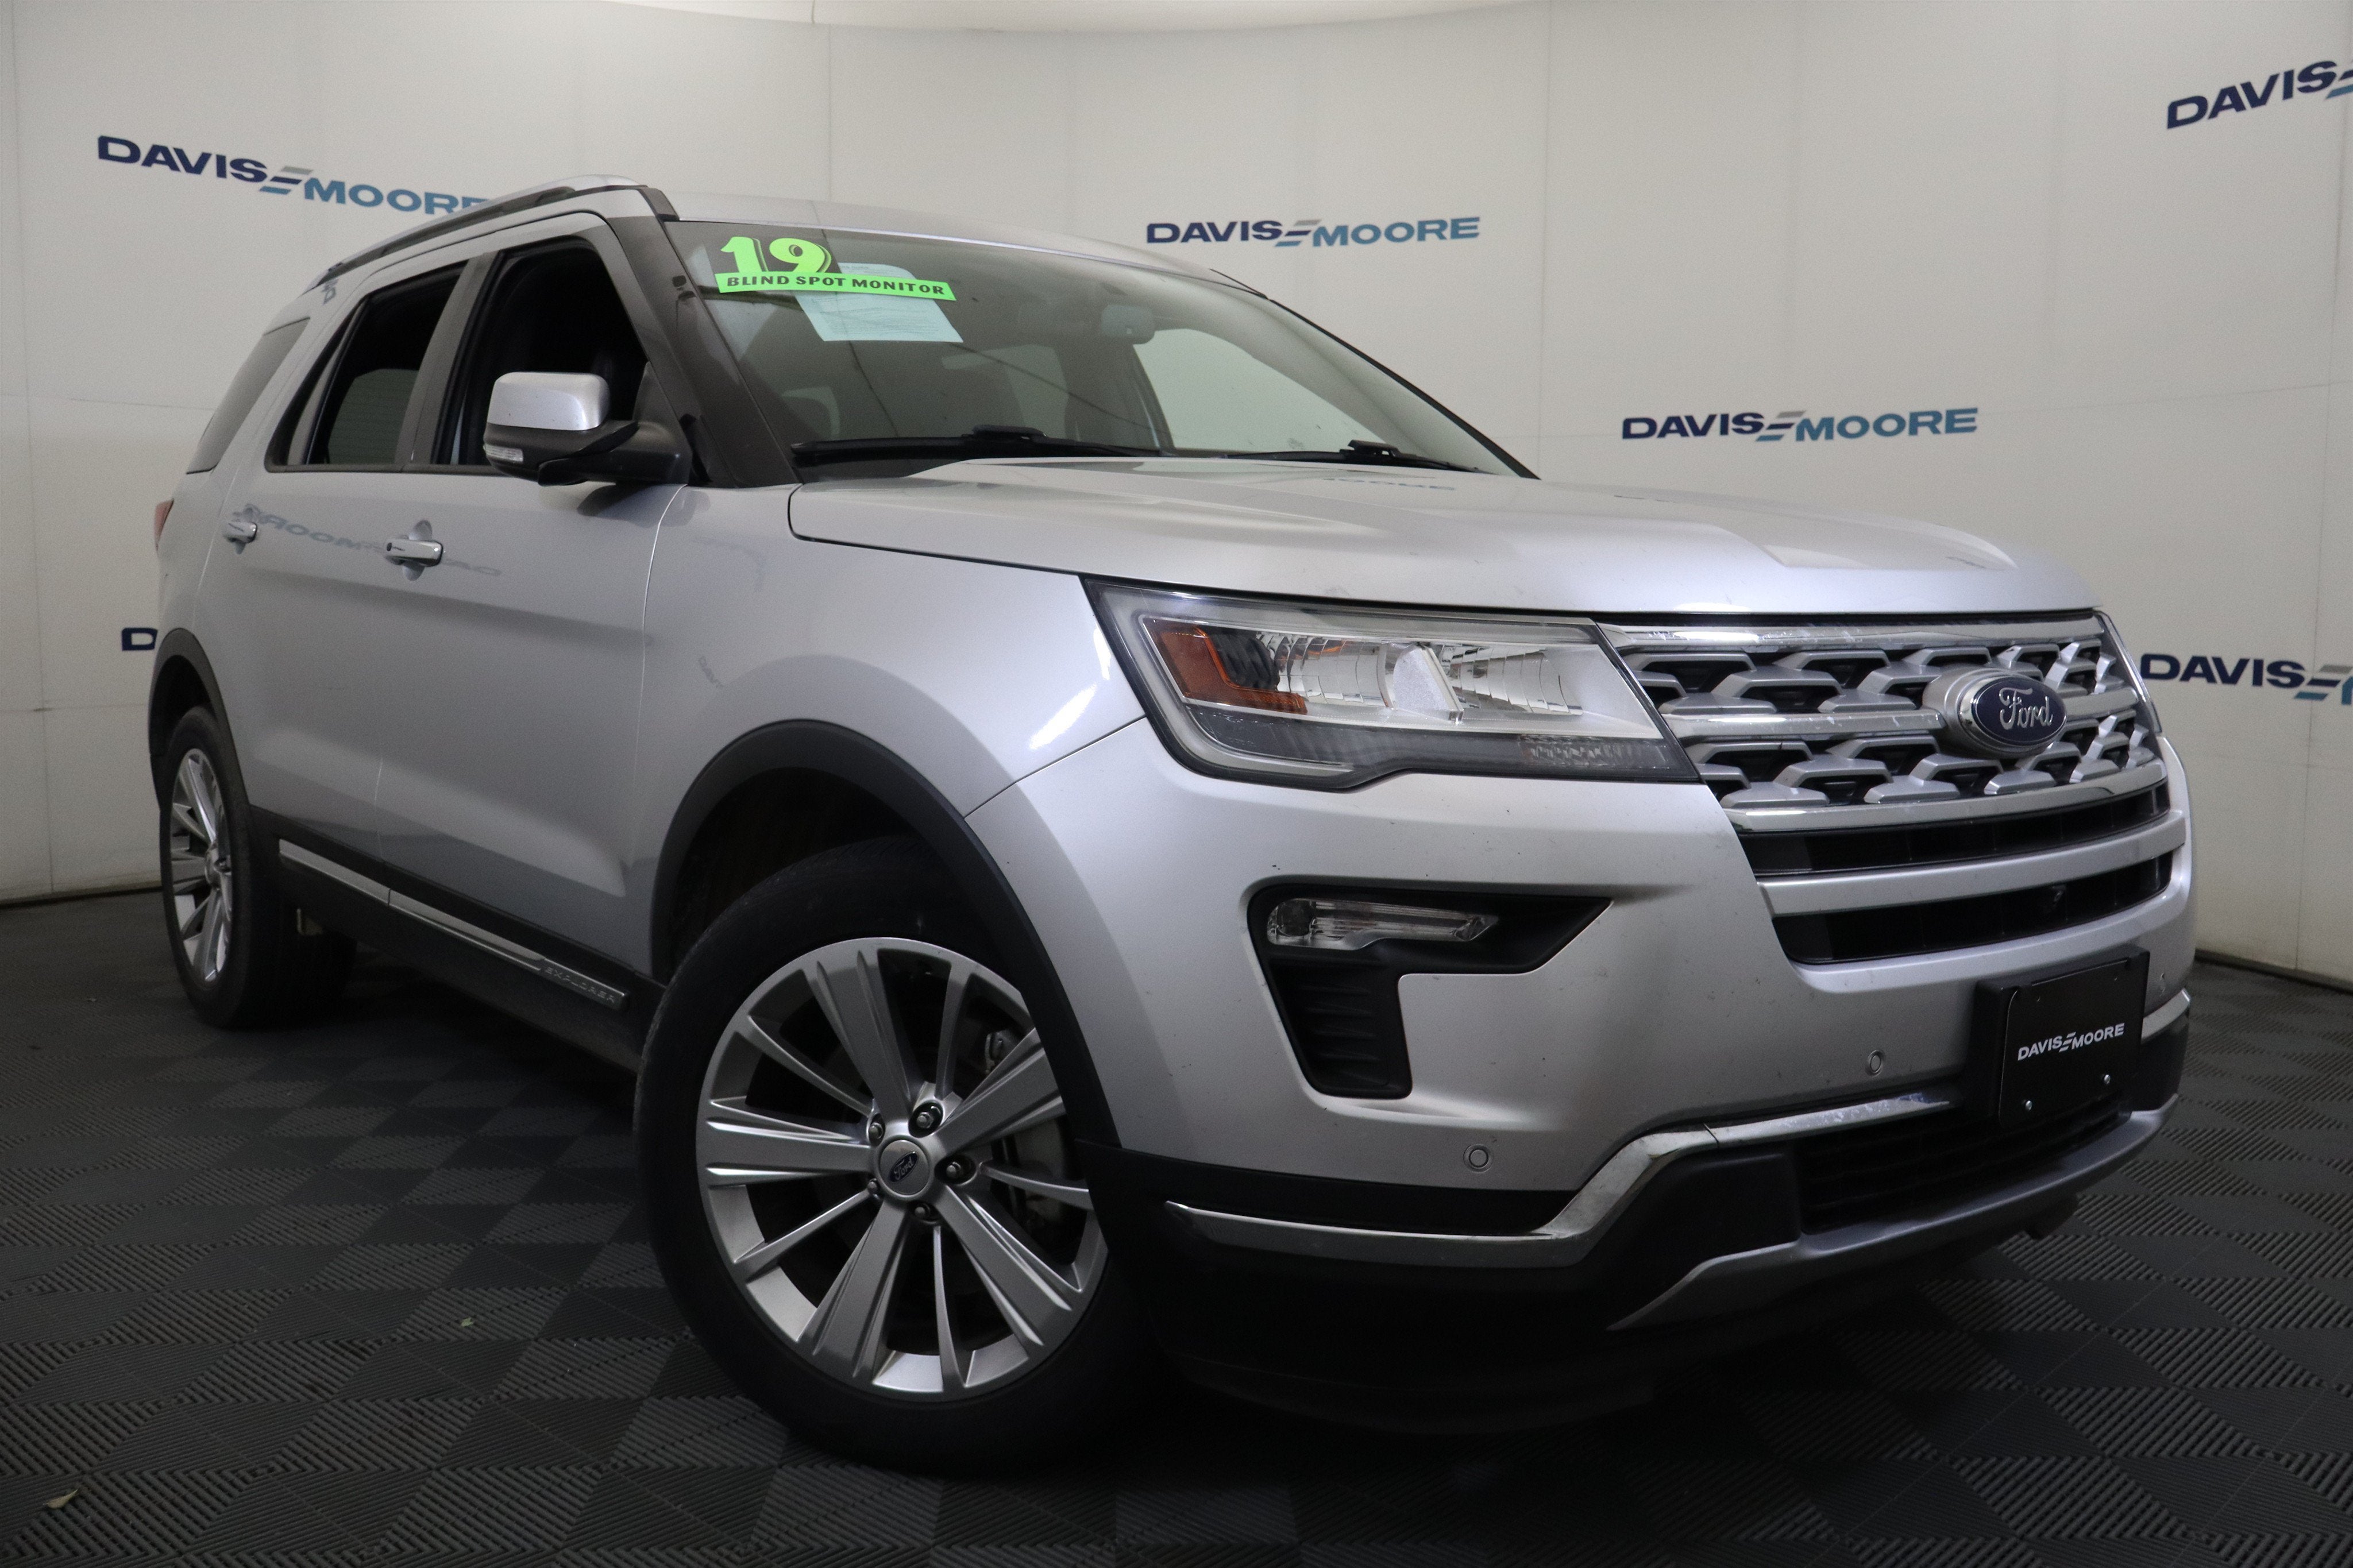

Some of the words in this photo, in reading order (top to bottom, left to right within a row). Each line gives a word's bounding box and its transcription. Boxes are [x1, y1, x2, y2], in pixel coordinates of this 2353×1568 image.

[2167, 60, 2338, 129] DAVIS
[98, 135, 268, 183] DAVIS
[1147, 221, 1282, 244] DAVIS
[1312, 217, 1480, 247] MOORE
[720, 236, 832, 273] 19
[727, 276, 790, 287] BLIND
[795, 276, 847, 287] SPOT
[851, 278, 946, 295] MONITOR
[1622, 412, 1765, 440] DAVIS
[1795, 408, 1978, 442] MOORE
[2140, 653, 2306, 689] DAVIS
[1999, 687, 2053, 730] Ford
[2017, 1035, 2063, 1061] DAVIS
[2071, 1022, 2125, 1050] MOORE
[893, 1156, 914, 1180] Ford
